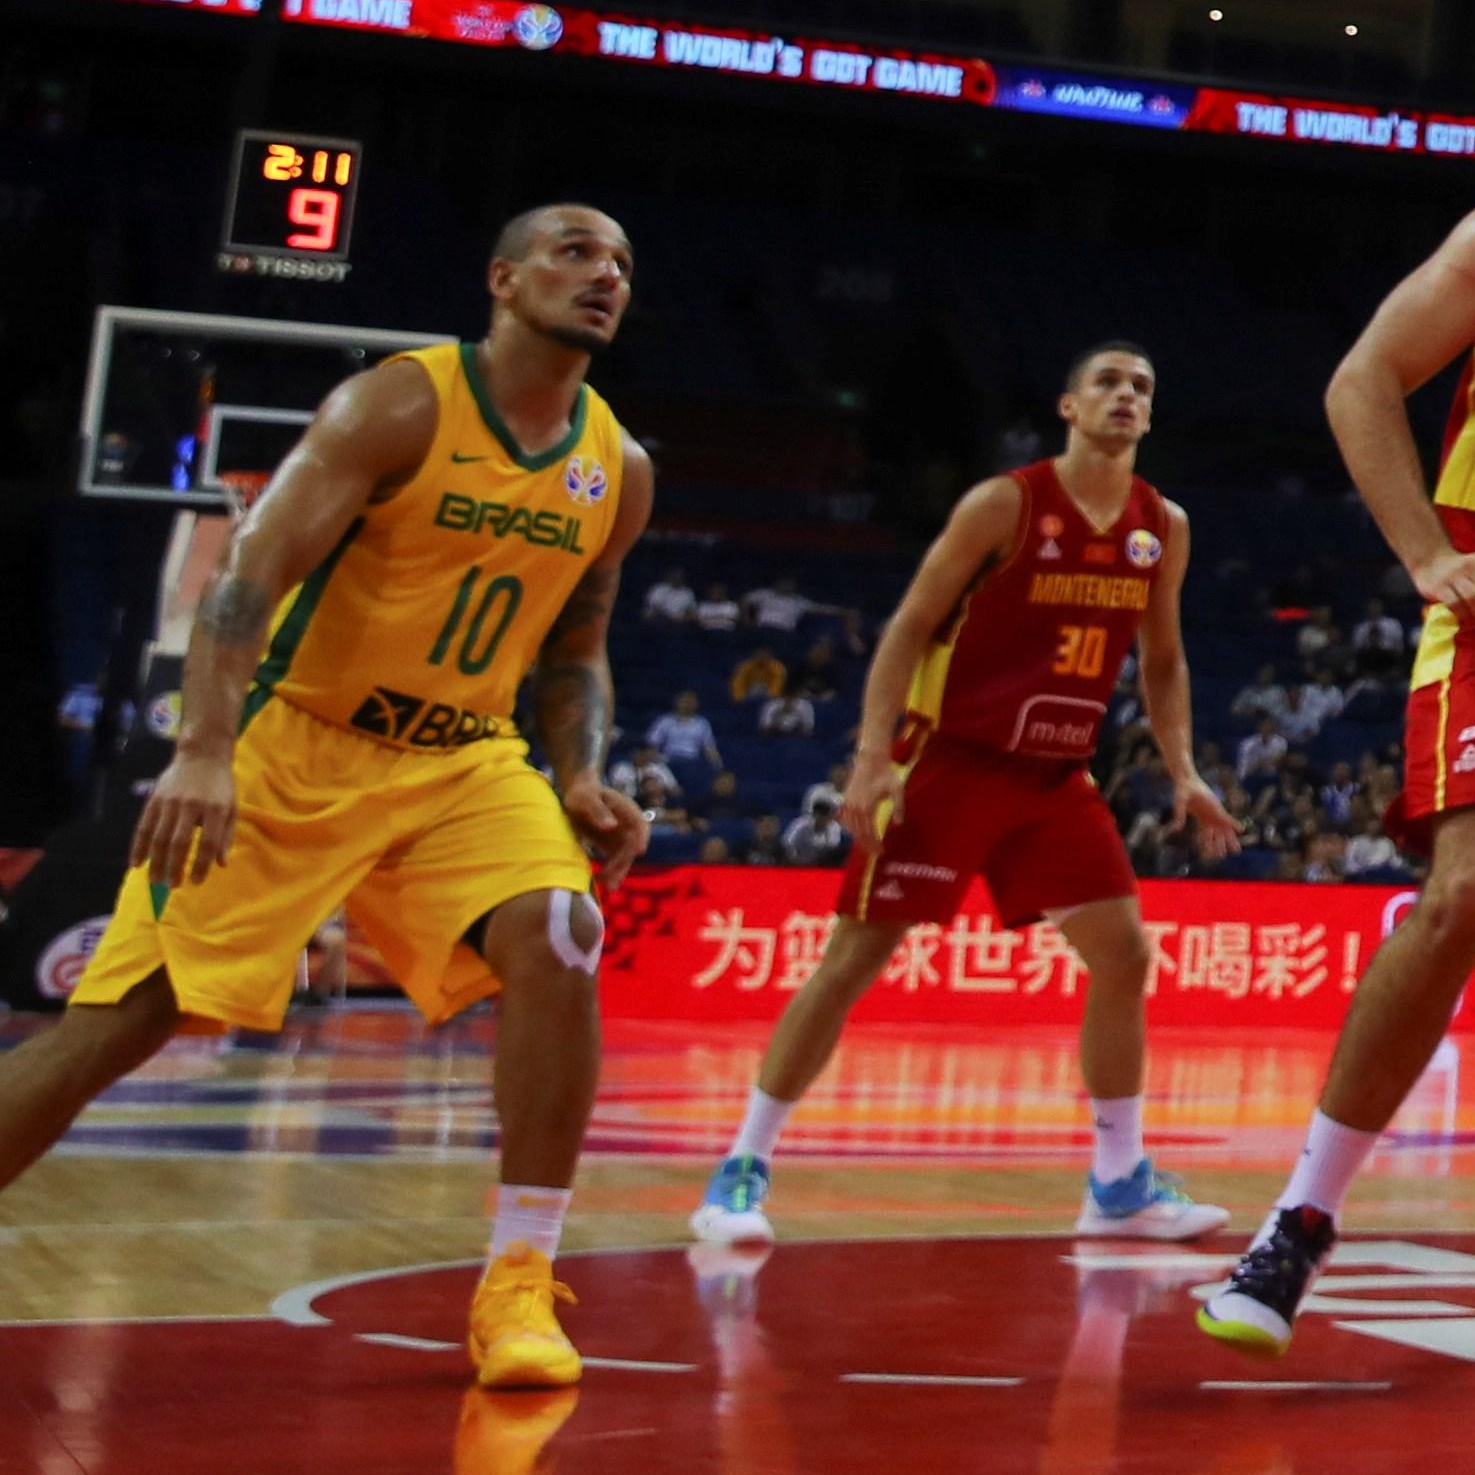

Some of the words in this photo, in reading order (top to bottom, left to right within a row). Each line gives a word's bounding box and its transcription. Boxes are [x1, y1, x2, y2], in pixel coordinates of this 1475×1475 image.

[598, 21, 656, 60] THE
[663, 34, 803, 78] WORLD'S
[812, 48, 872, 86] GOT
[874, 56, 963, 97] GAME
[1236, 102, 1286, 136] THE
[1294, 111, 1417, 150] WORLD'S
[263, 144, 351, 186] 2:11
[287, 188, 341, 250] 9
[256, 256, 352, 282] TISSOT
[434, 492, 584, 556] BRASIL
[427, 565, 523, 676] 10
[1053, 625, 1107, 678] 30
